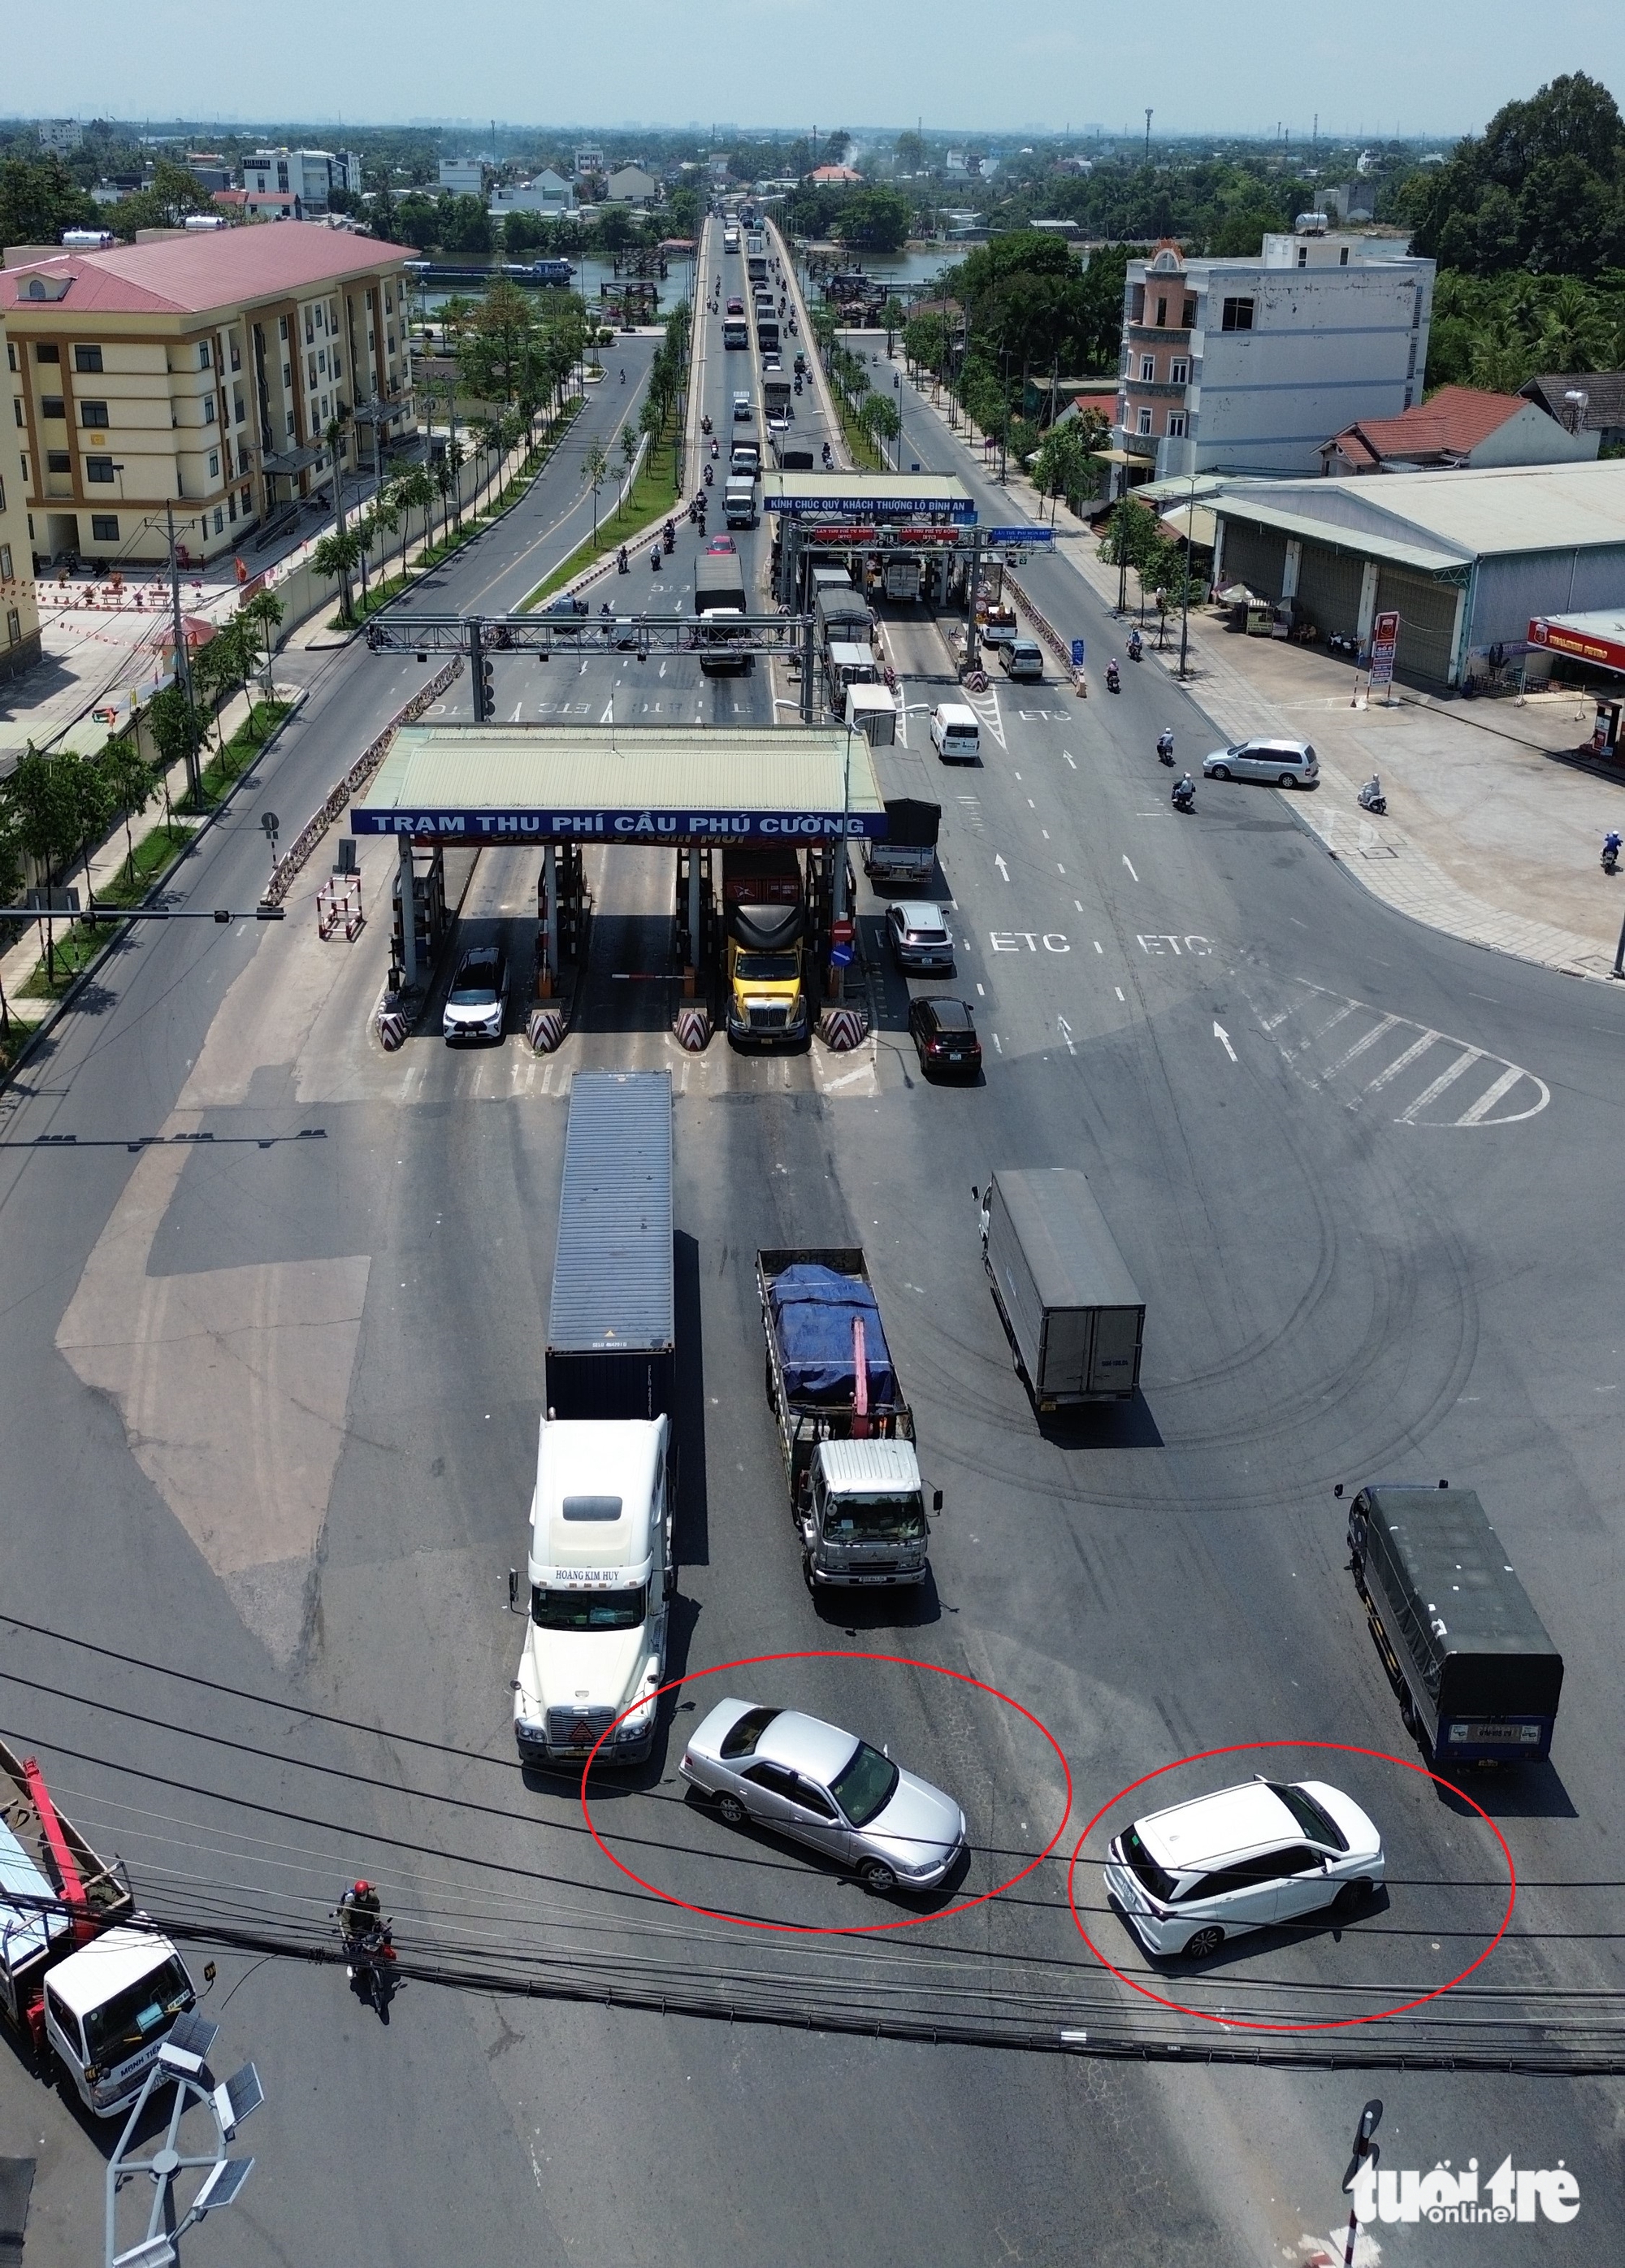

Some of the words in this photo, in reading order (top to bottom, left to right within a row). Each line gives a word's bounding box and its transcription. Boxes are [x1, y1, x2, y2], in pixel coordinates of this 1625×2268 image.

[770, 497, 792, 509] KÍNH
[795, 498, 820, 509] CHÚC
[821, 498, 840, 510] QUÝ
[843, 498, 873, 510] KHÁCH
[876, 499, 912, 511] THƯỢNG
[914, 499, 926, 512] LỘ
[929, 499, 950, 511] BÌNH
[952, 501, 965, 511] AN
[1018, 710, 1072, 722] ETC
[371, 816, 466, 834] TRẠM
[476, 816, 540, 831] THU
[552, 813, 605, 831] PHÍ
[613, 811, 677, 832] CẦU
[689, 813, 751, 833] PHÚ
[759, 814, 864, 834] CƯỜNG
[989, 931, 1071, 952] ETC
[1136, 934, 1215, 955] ETC
[584, 1570, 600, 1581] KIM
[602, 1570, 620, 1581] HUY
[120, 2056, 145, 2077] MẠNH
